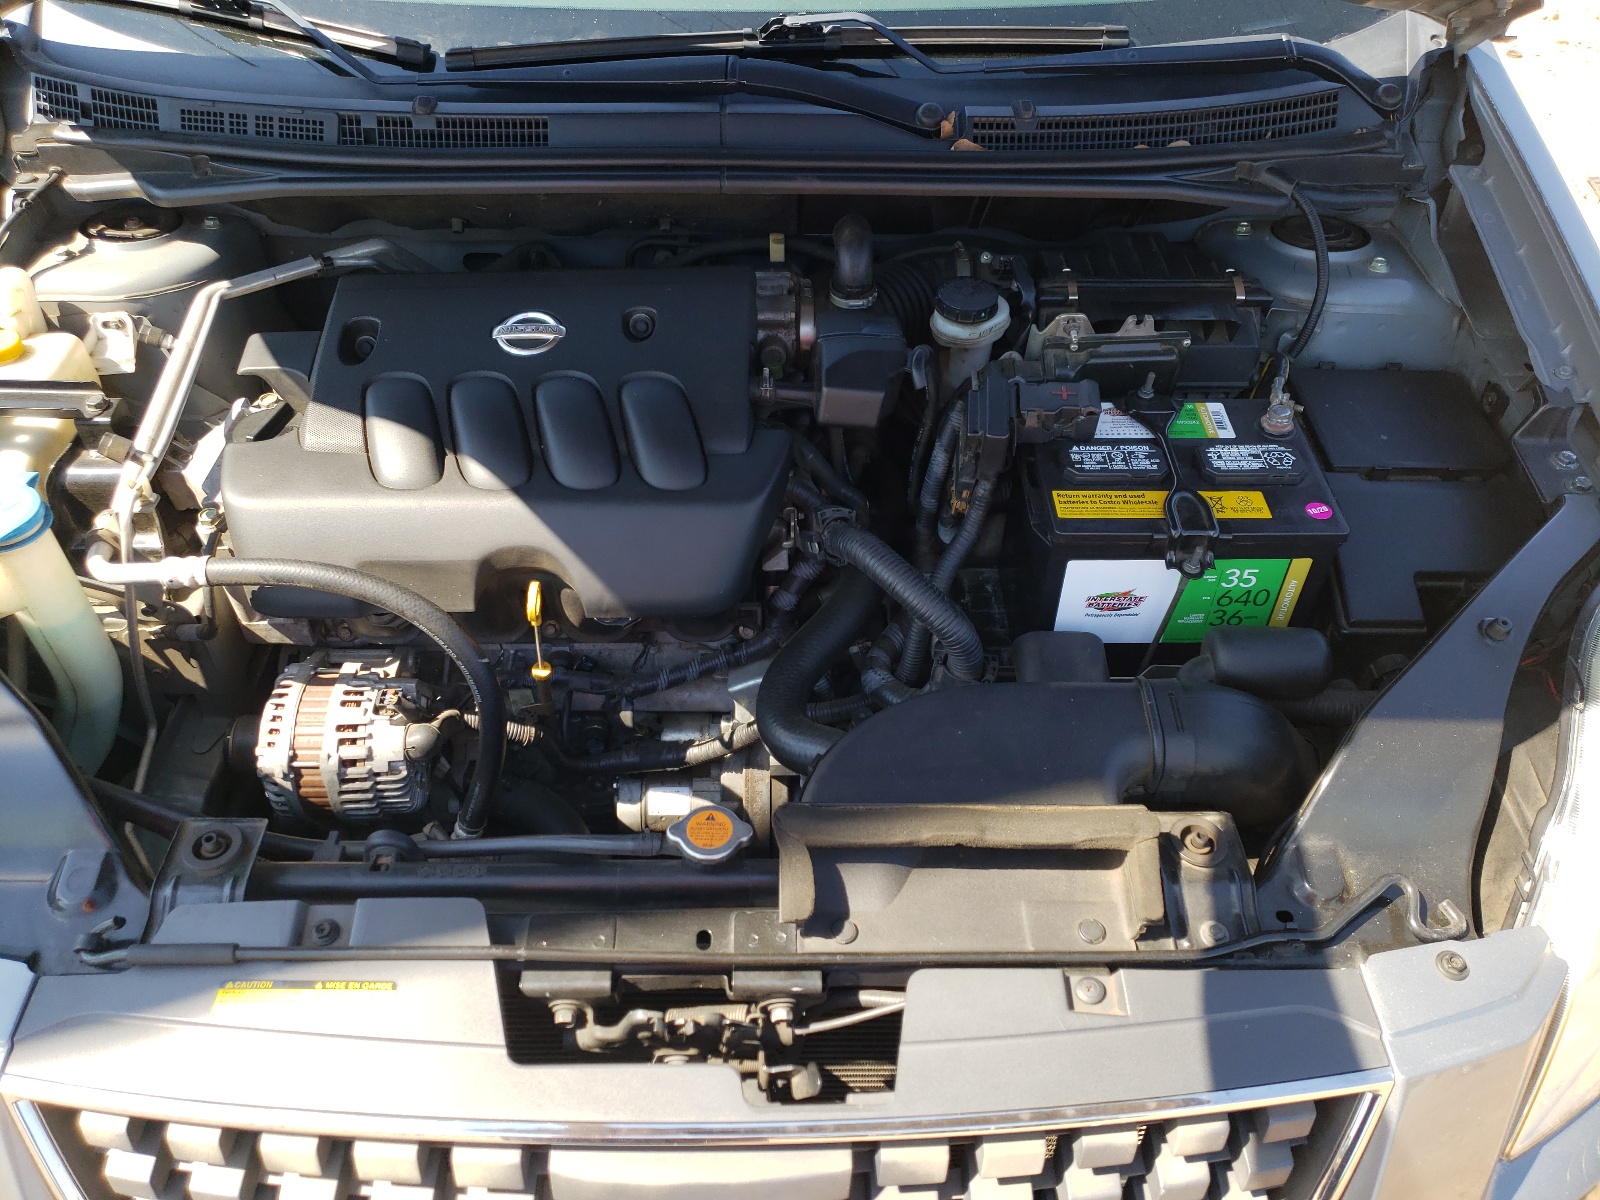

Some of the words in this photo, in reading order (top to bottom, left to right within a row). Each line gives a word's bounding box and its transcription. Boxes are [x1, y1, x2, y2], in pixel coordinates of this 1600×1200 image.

[500, 325, 559, 334] NISSAN
[1307, 505, 1329, 515] 10/20
[1221, 568, 1259, 588] 35
[1216, 588, 1271, 607] 640
[1277, 579, 1299, 621] AUTOMOTIVE
[1208, 609, 1243, 627] 36
[234, 980, 274, 989] CAUTION
[325, 981, 346, 990] MISE
[348, 981, 362, 990] EN
[363, 981, 394, 990] GARDE
